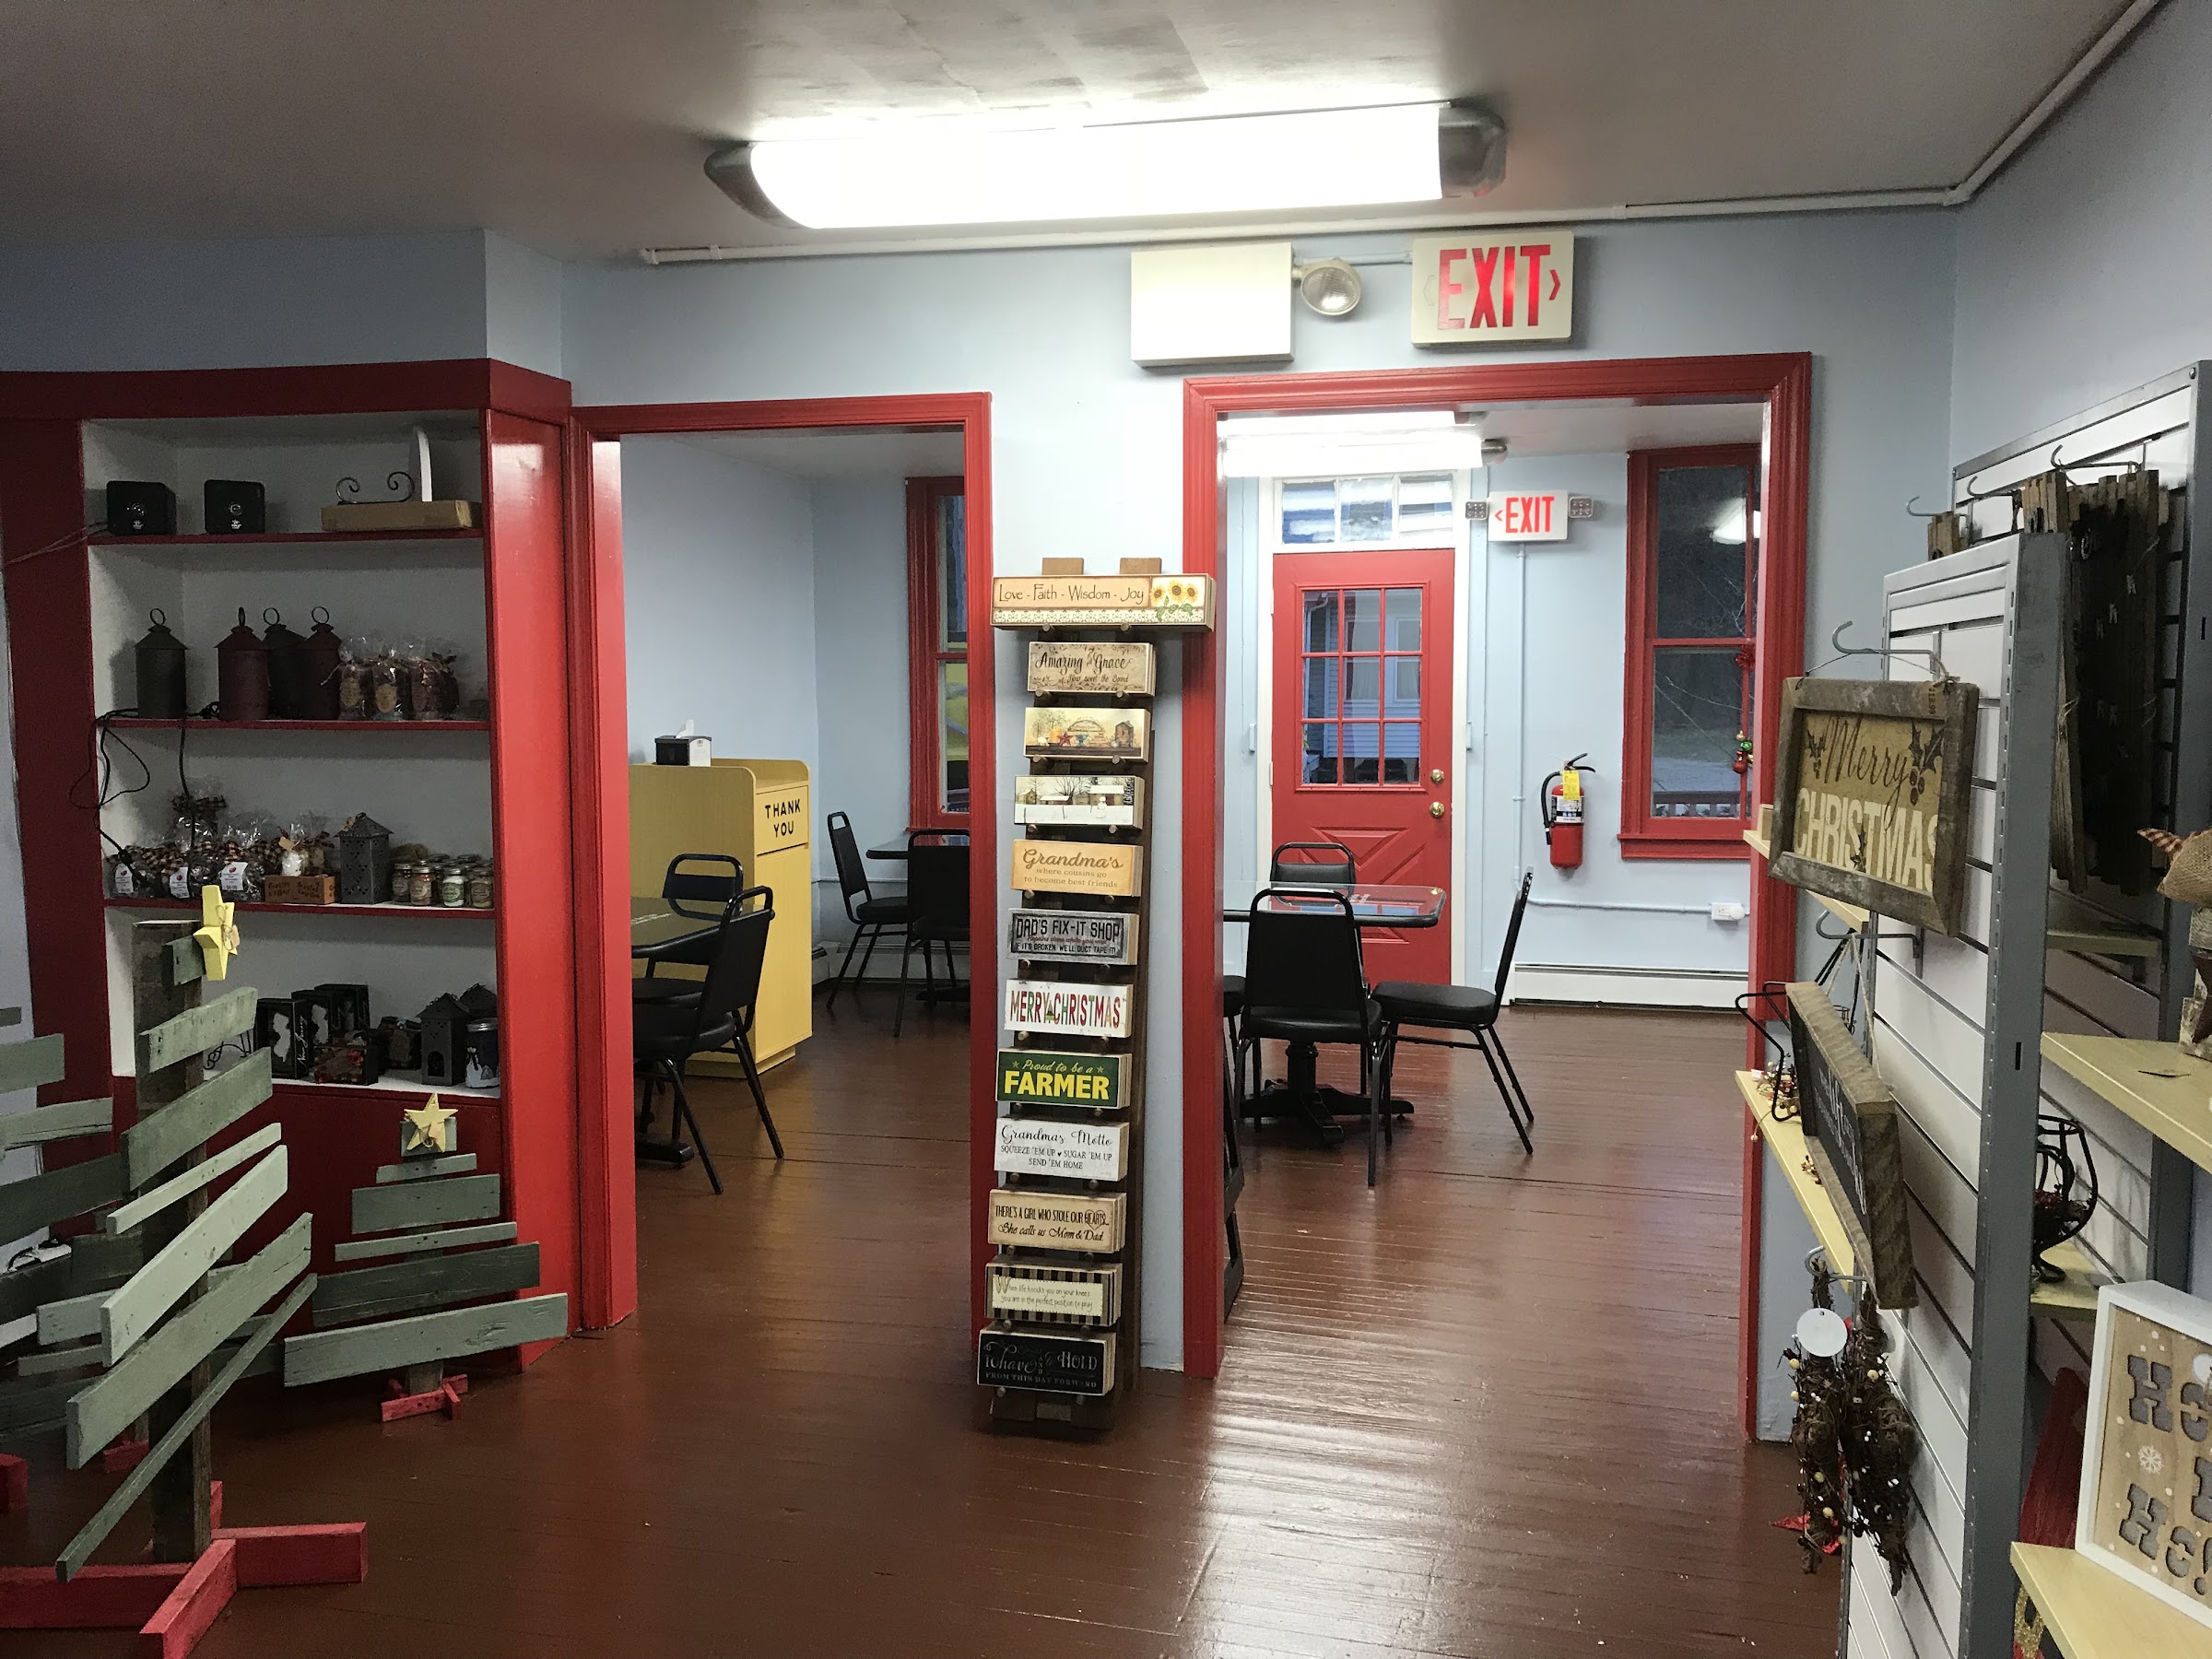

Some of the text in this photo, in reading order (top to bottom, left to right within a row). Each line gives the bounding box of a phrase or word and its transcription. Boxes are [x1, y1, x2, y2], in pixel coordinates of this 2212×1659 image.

[1438, 244, 1551, 330] EXIT
[1505, 496, 1555, 534] EXIT
[998, 583, 1023, 602] Love
[1033, 583, 1057, 601] Faith
[1067, 584, 1110, 601] Wisdom
[1121, 586, 1144, 605] Joy
[1035, 652, 1134, 676] Amazing Grace
[1069, 674, 1081, 682] How
[1100, 674, 1109, 682] the
[1825, 714, 1910, 831] Merry
[765, 798, 801, 819] THANK
[773, 820, 794, 839] YOU
[1023, 848, 1124, 869] Grandma's
[1034, 876, 1065, 885] become
[1067, 877, 1085, 886] best
[1088, 879, 1118, 888] friends
[1017, 918, 1120, 942] DAD'S FIX-IT SHOP
[1010, 990, 1121, 1029] MERRY CHRISTMAS
[1022, 1060, 1056, 1072] Proud
[1055, 1062, 1067, 1073] to
[1071, 1062, 1082, 1073] be
[1005, 1070, 1110, 1100] FARMER
[1071, 1129, 1113, 1146] Motto
[1001, 1145, 1112, 1161] SQUEEZE 'EM UP SUGAR 'EM UP
[1029, 1158, 1083, 1170] SEND 'EM HOME
[995, 1205, 1017, 1218] THERE'S
[1018, 1207, 1022, 1218] A
[1024, 1207, 1036, 1219] GIRL
[1038, 1208, 1051, 1220] WHO
[1053, 1210, 1069, 1222] STOLE
[1071, 1212, 1083, 1223] OUR
[998, 1222, 1017, 1233] She
[1019, 1225, 1036, 1235] calls
[1049, 1227, 1075, 1239] Mom
[1076, 1230, 1082, 1240] &
[994, 1275, 1018, 1294] When
[1045, 1289, 1054, 1299] you
[1036, 1298, 1053, 1307] perfect
[1054, 1300, 1075, 1308] position
[1075, 1300, 1080, 1309] to
[1081, 1301, 1093, 1312] pray
[999, 1345, 1038, 1373] have
[1057, 1351, 1098, 1371] HOLD
[985, 1371, 1010, 1381] FROM
